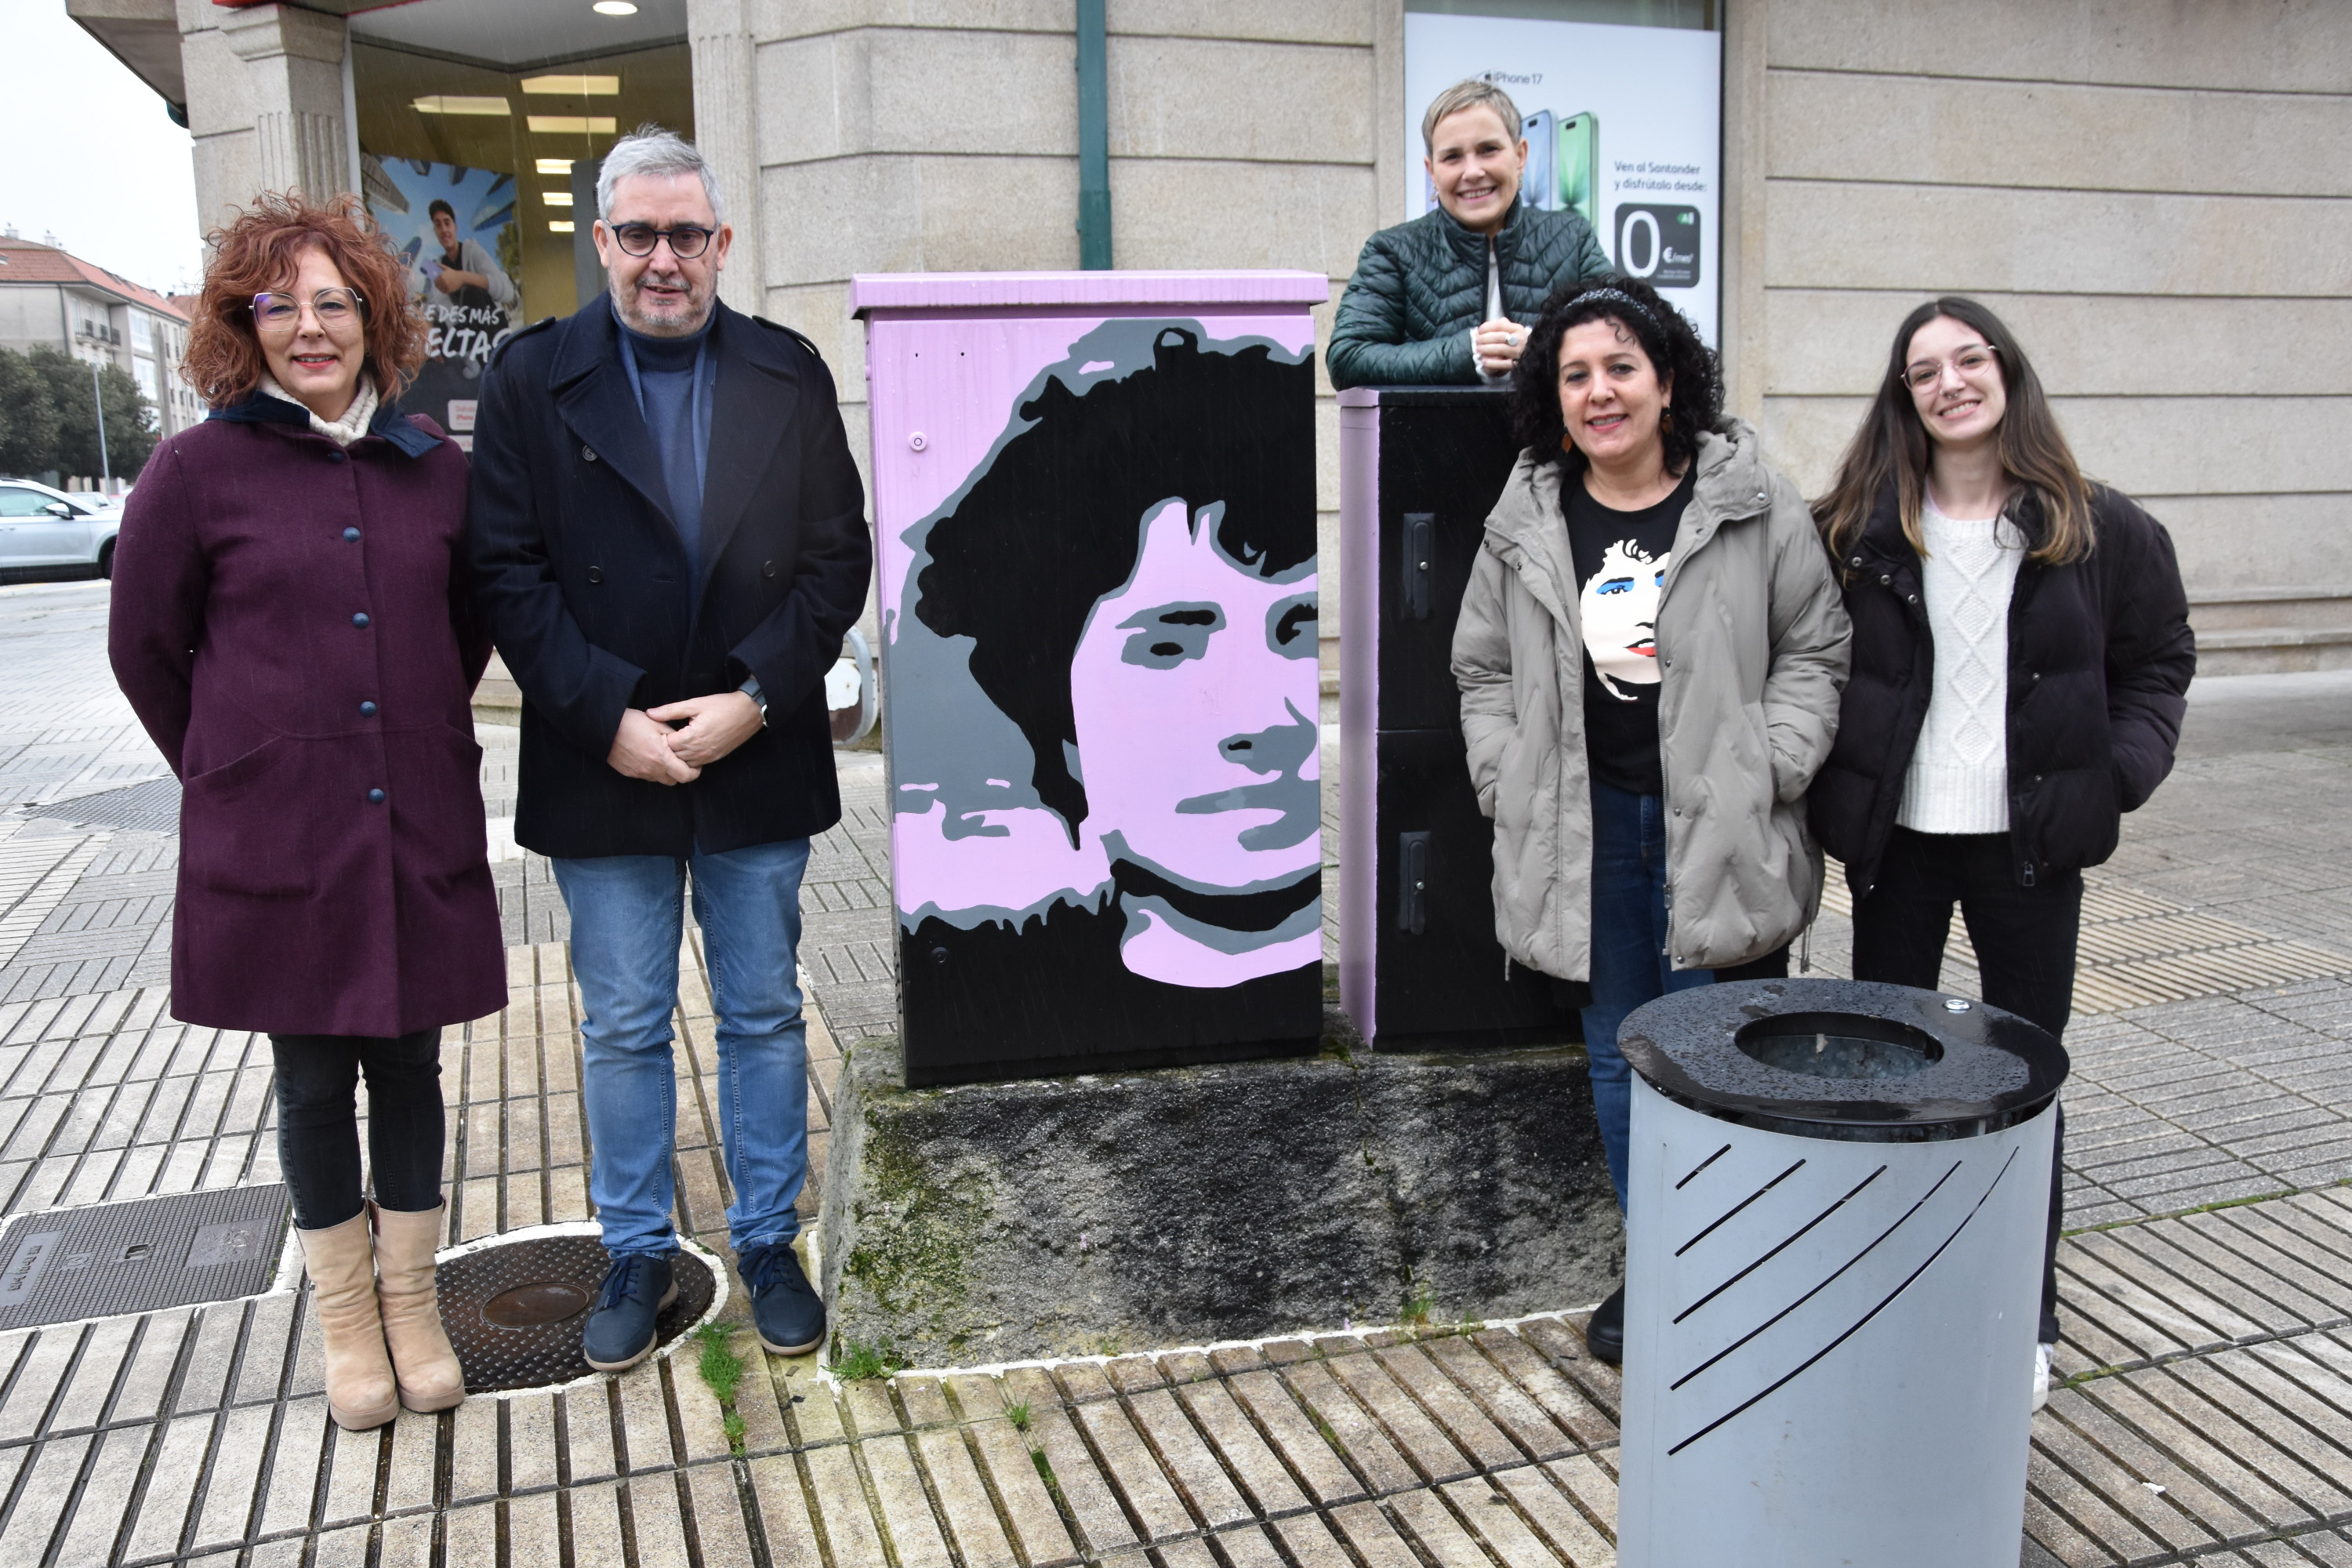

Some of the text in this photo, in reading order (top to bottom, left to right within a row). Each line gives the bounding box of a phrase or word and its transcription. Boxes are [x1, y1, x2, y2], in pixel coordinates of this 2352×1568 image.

[1532, 73, 1543, 85] 17
[1613, 161, 1700, 174] Ven al Santander
[1613, 178, 1708, 191] y disfrútalo desde:
[1621, 209, 1661, 278] 0
[469, 305, 503, 325] MÁS
[412, 326, 513, 363] ELTA
